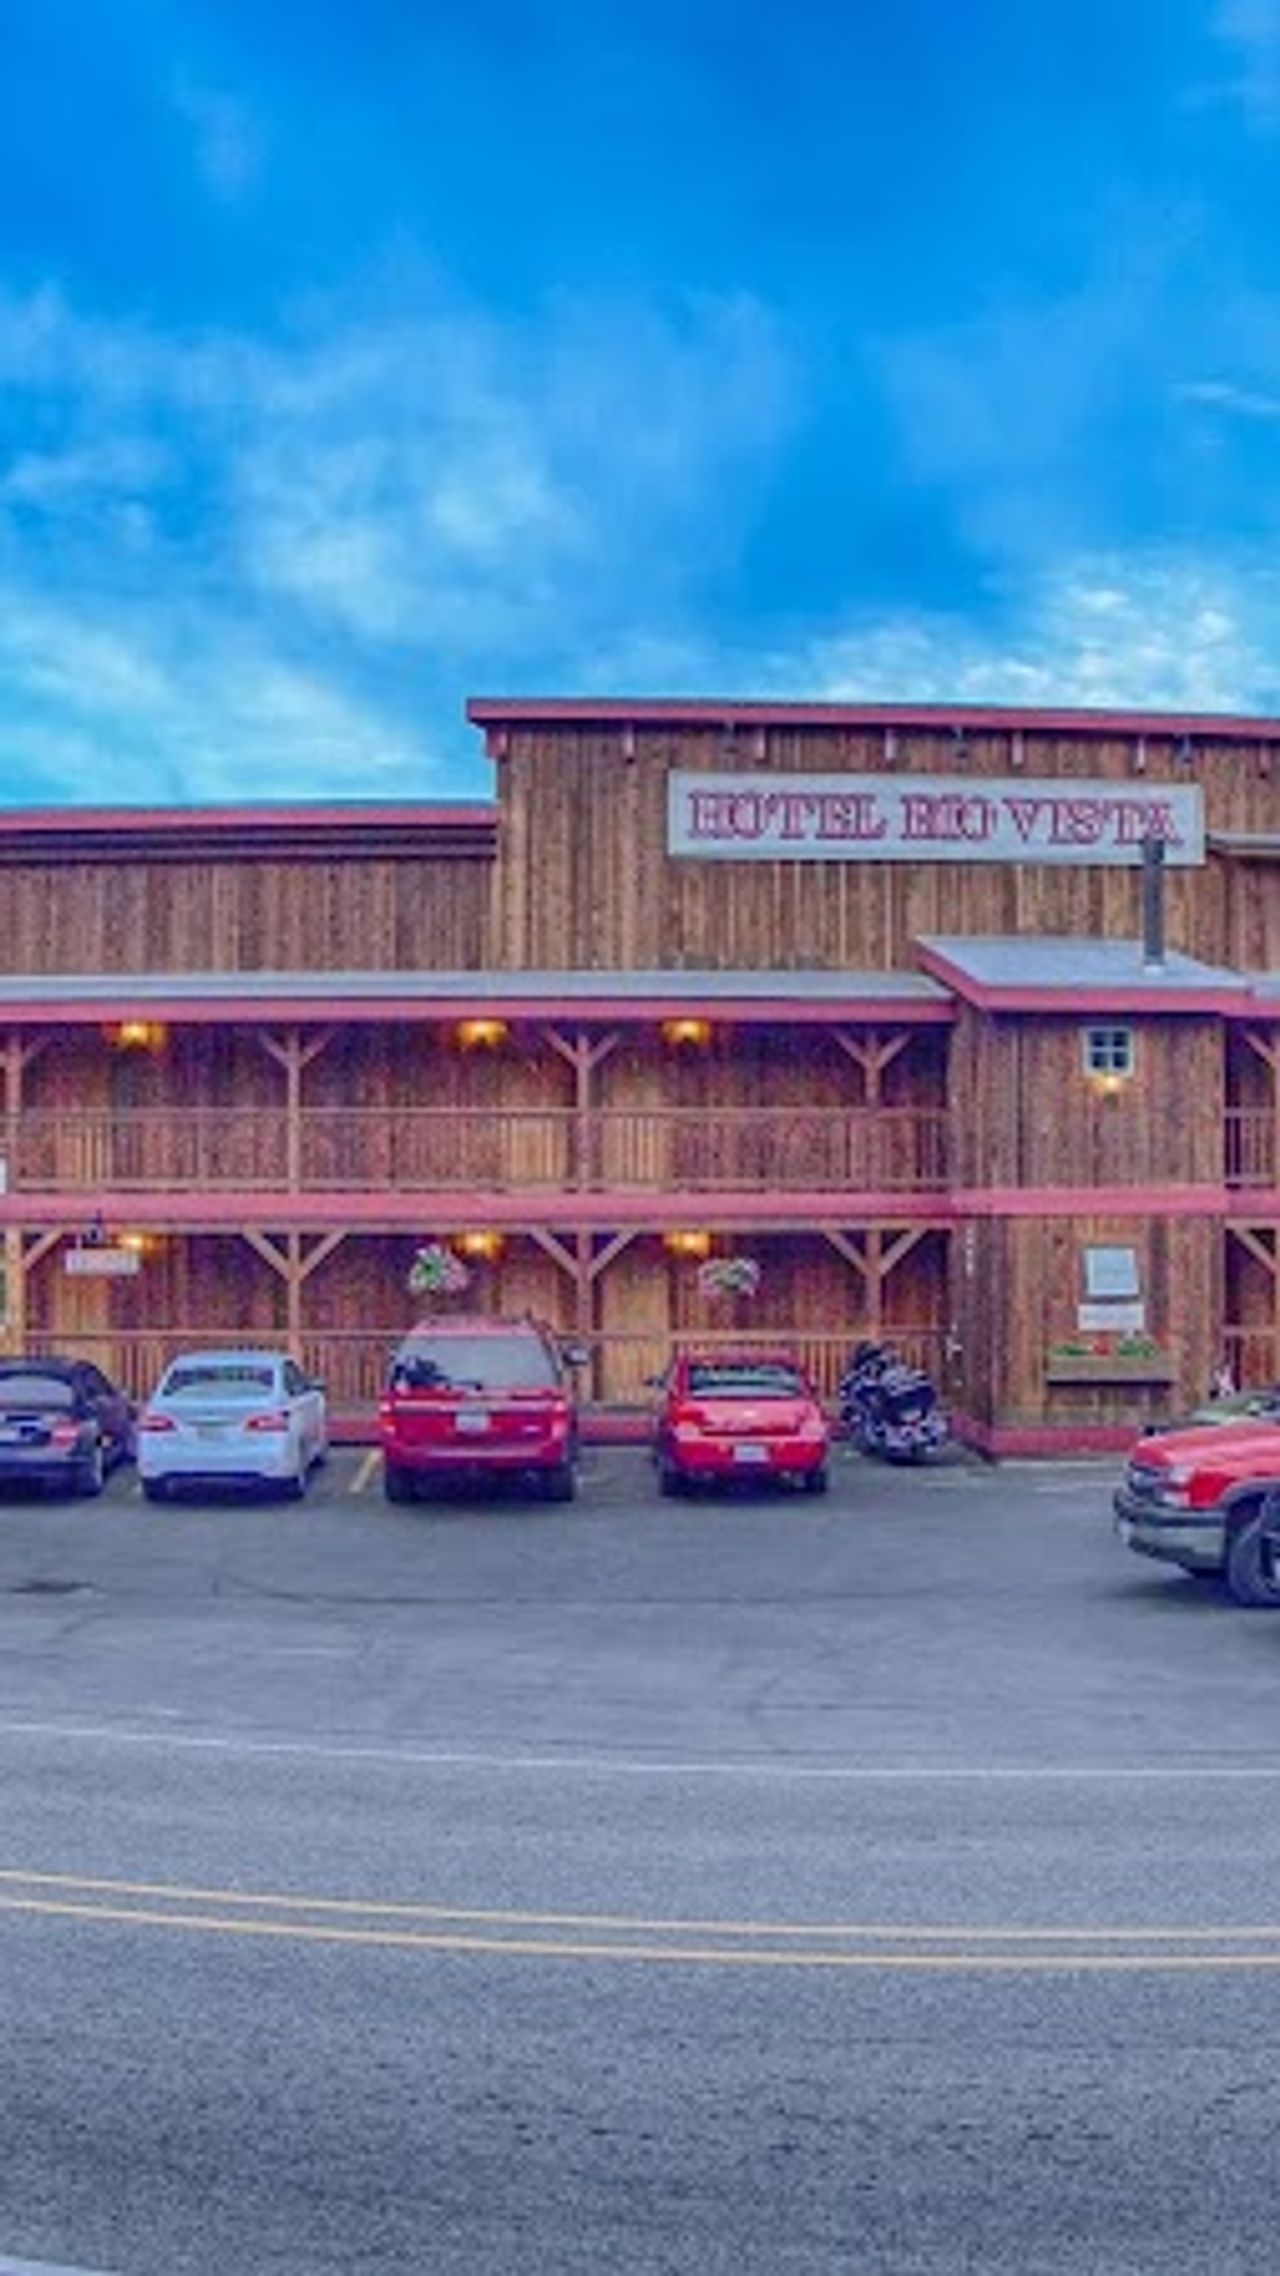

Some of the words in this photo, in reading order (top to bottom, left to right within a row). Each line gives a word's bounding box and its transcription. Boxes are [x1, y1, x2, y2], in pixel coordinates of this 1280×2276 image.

[688, 790, 887, 841] HOTEL
[900, 793, 998, 842] RIO
[1002, 797, 1184, 847] VISTA
